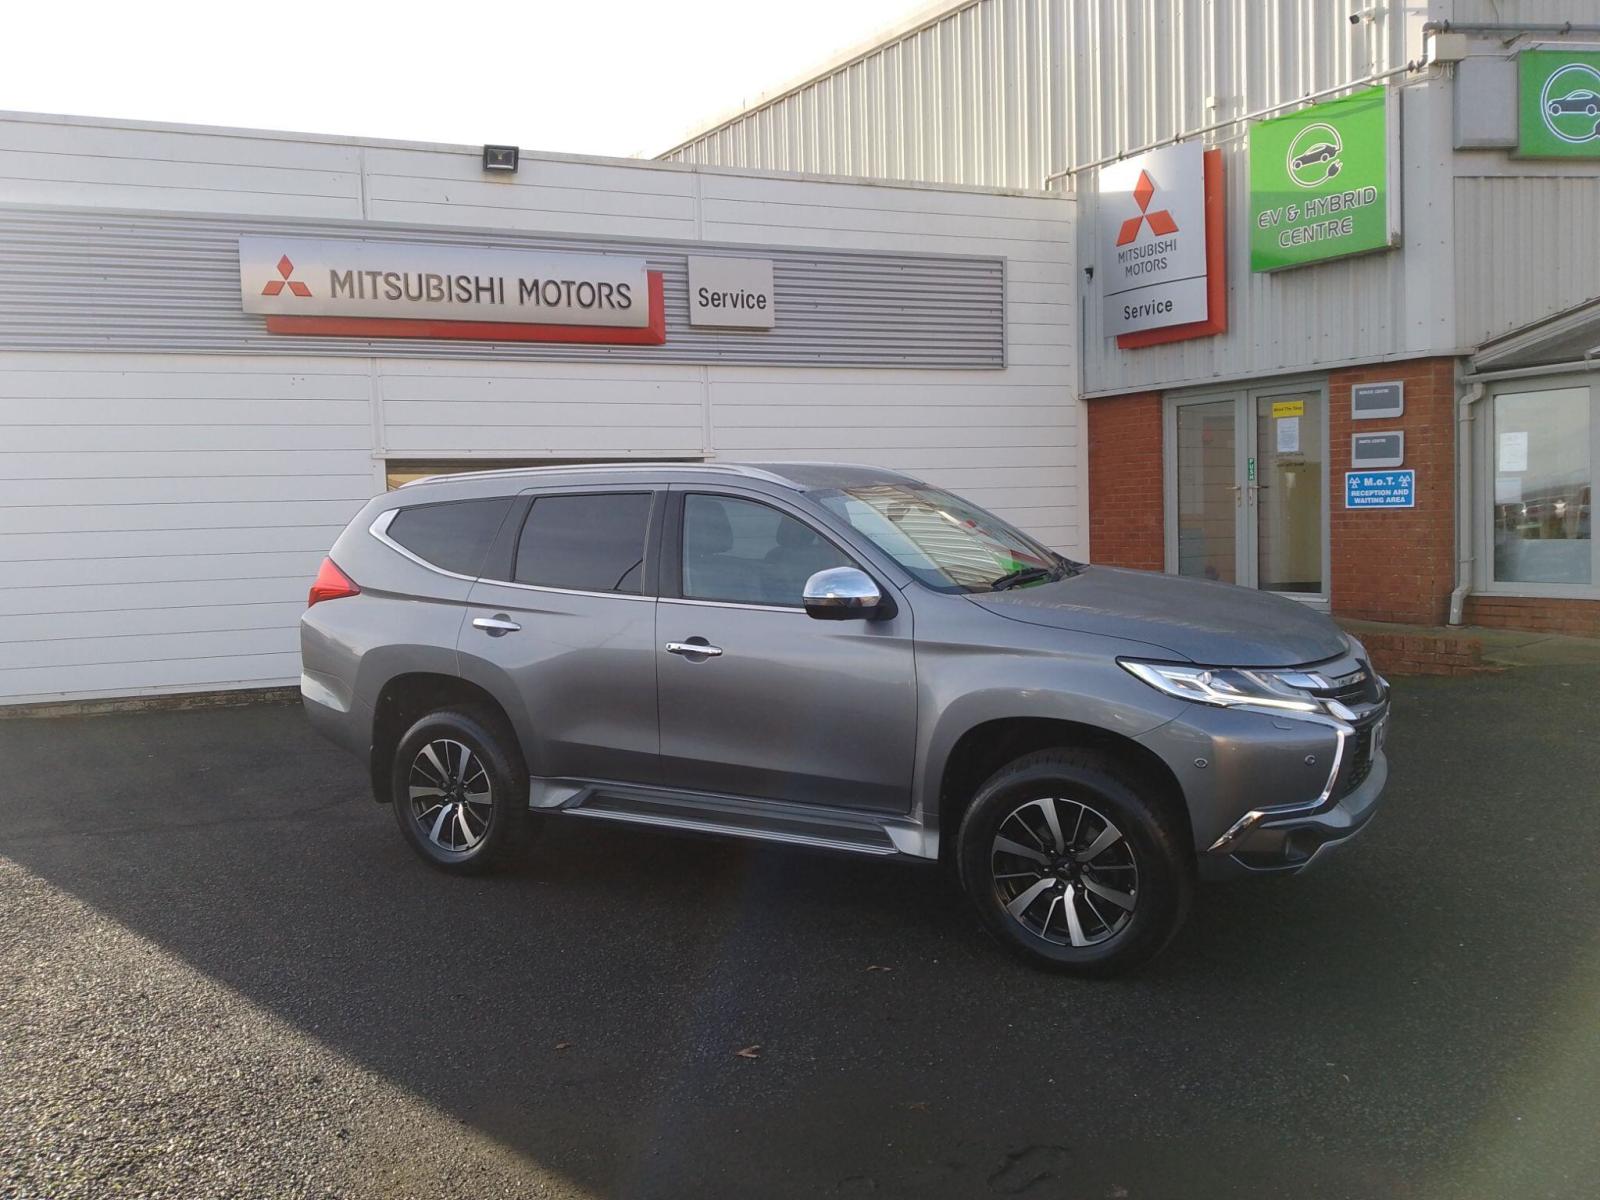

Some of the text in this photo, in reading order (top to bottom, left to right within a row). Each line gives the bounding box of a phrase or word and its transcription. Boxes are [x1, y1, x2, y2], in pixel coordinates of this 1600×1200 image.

[1258, 186, 1377, 229] EV & HYBRID
[1279, 216, 1353, 248] CENTRE
[1118, 239, 1177, 264] MITSUBISHI
[1125, 257, 1168, 278] MOTORS
[329, 269, 632, 310] MITSUBISHI MOTORS
[698, 287, 767, 310] Service
[1123, 298, 1173, 321] Service
[1351, 488, 1409, 497] RECEPTION AND
[1364, 476, 1395, 486] M.o.T.
